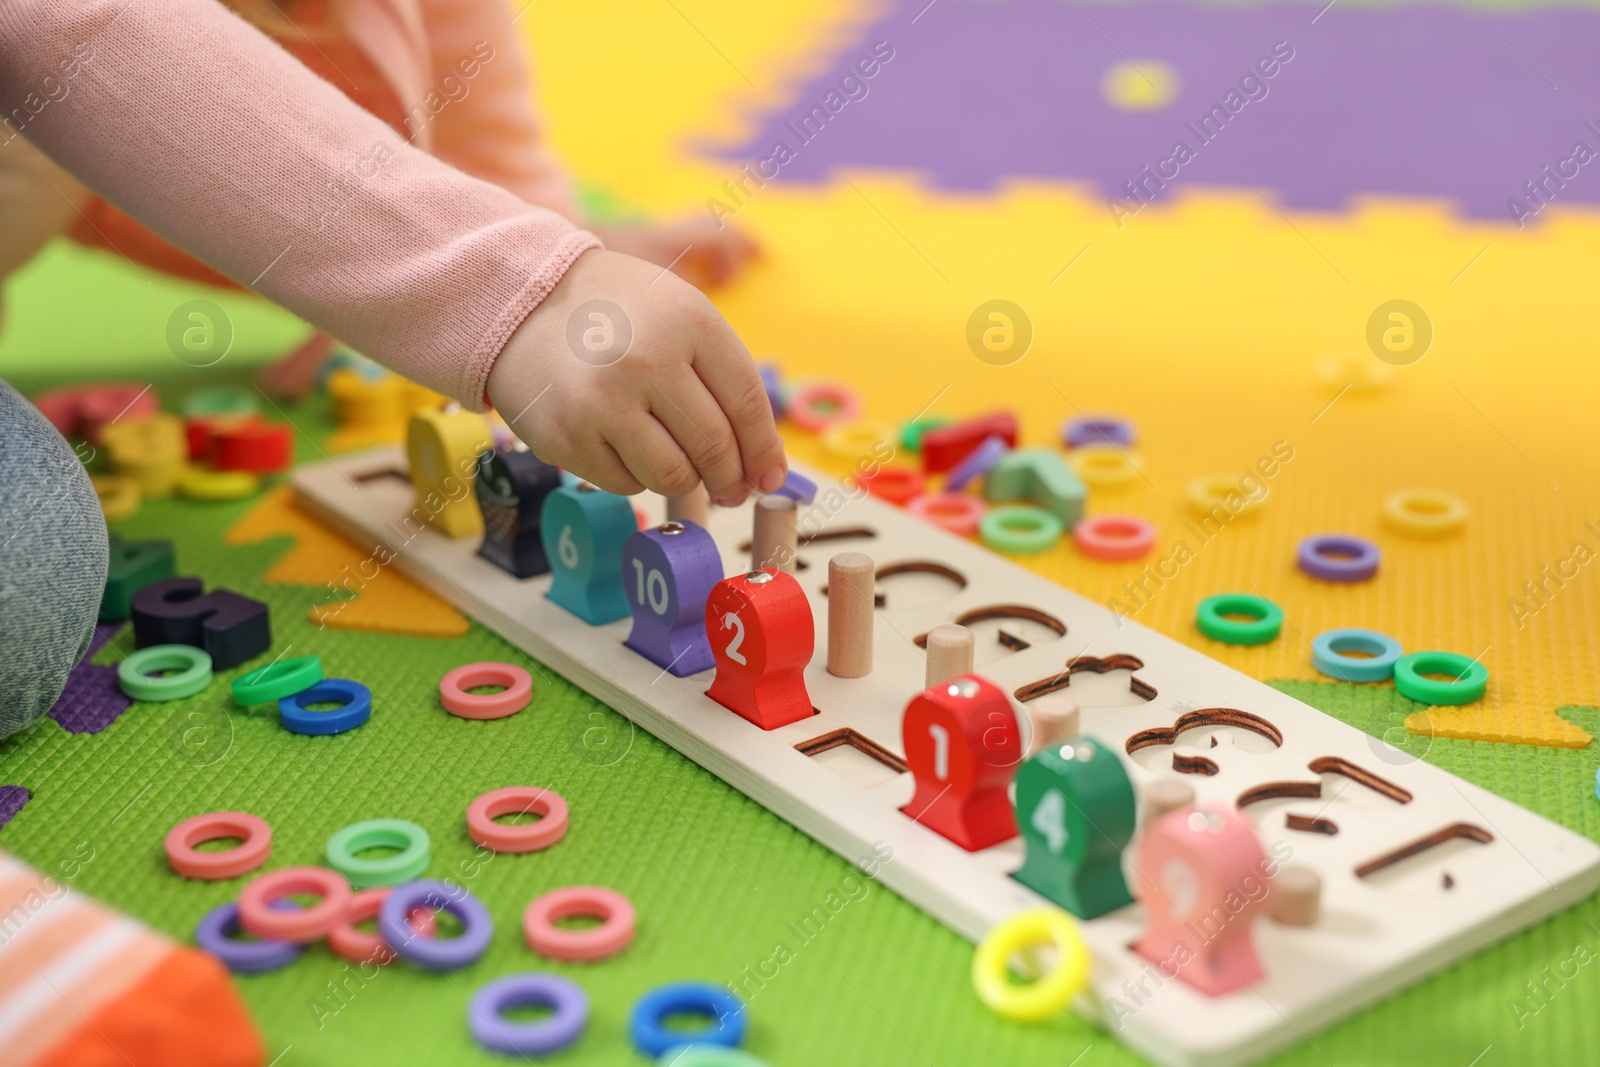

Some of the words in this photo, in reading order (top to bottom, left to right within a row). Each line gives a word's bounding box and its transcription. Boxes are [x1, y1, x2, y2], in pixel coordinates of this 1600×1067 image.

[558, 524, 579, 569] 6
[632, 558, 668, 615] 10
[725, 612, 747, 666] 2
[929, 723, 950, 781] 1
[1031, 789, 1069, 854] 4
